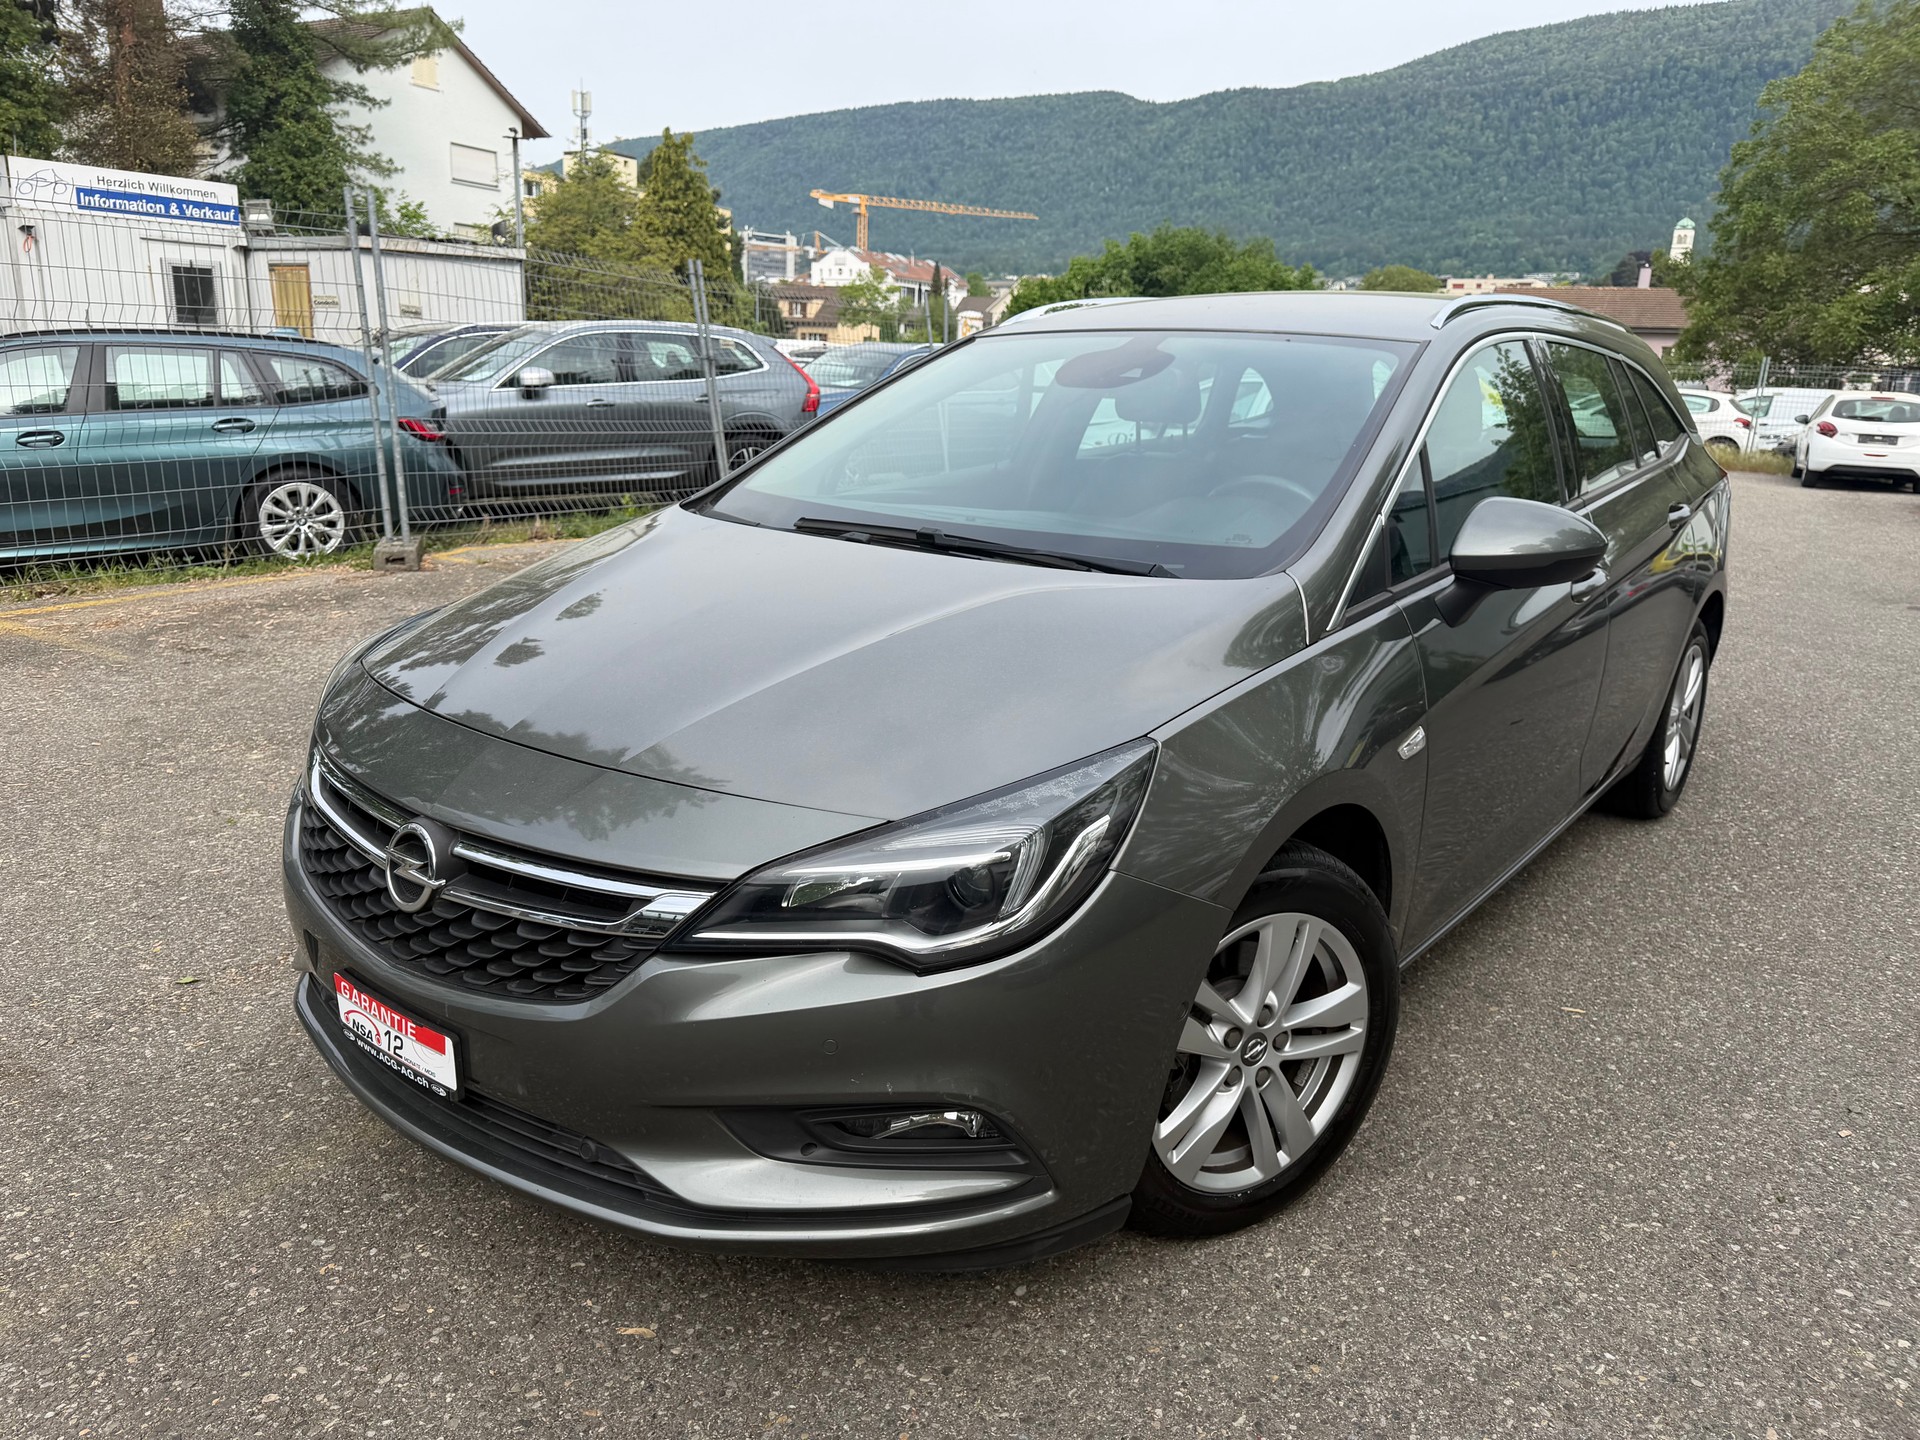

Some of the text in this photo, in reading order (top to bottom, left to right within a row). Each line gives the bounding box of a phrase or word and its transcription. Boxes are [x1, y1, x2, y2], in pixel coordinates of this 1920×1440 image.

[97, 176, 217, 199] Herzlich Willkommen
[79, 192, 235, 222] Information & Verkauf
[340, 981, 417, 1041] GARANTIE
[352, 1018, 374, 1042] NSA
[384, 1029, 404, 1060] 12
[356, 1037, 430, 1089] www.ACG-AG.ch
